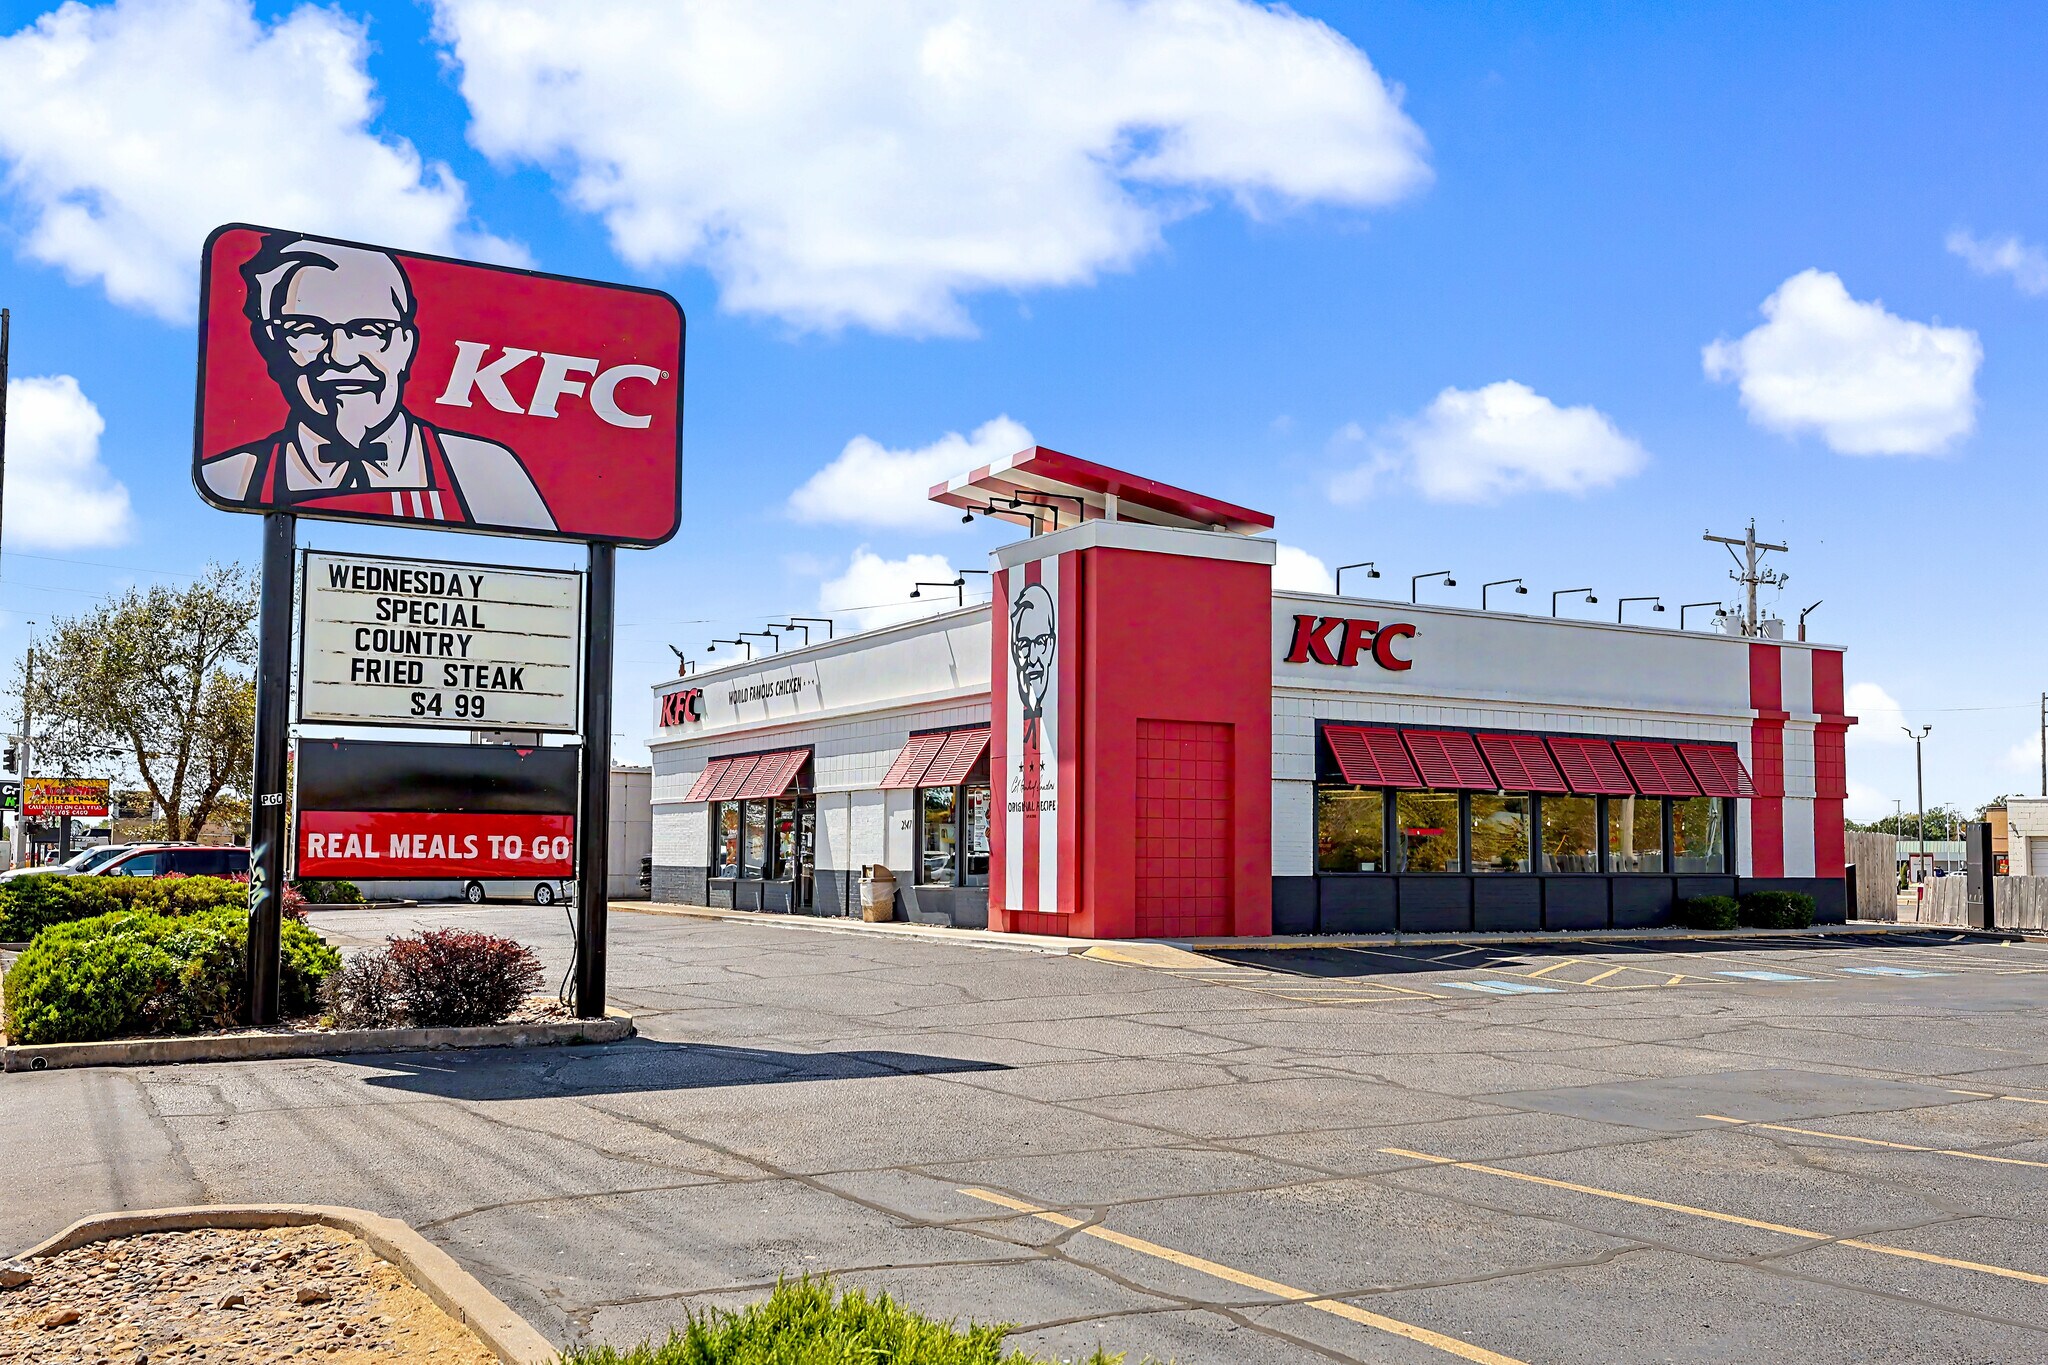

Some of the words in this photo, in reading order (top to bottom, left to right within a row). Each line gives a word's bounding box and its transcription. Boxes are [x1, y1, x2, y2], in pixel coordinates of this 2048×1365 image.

[436, 340, 662, 429] KFC
[328, 563, 484, 598] WEDNESDAY
[376, 598, 486, 629] SPECIAL
[355, 628, 473, 657] COUNTRY
[1283, 614, 1416, 671] KFC
[351, 658, 423, 685] FRIED
[443, 664, 524, 690] STEAK
[455, 694, 485, 718] 99
[728, 687, 748, 705] WORLD
[749, 682, 773, 701] FAMOUS
[775, 677, 802, 697] CHICKEN
[659, 688, 703, 727] KFC
[1007, 801, 1035, 812] ORIGINAL
[1036, 800, 1056, 811] RECIPE
[307, 833, 380, 858] REAL
[389, 834, 478, 859] MEALS
[488, 835, 522, 859] TO
[532, 836, 569, 860] GO
